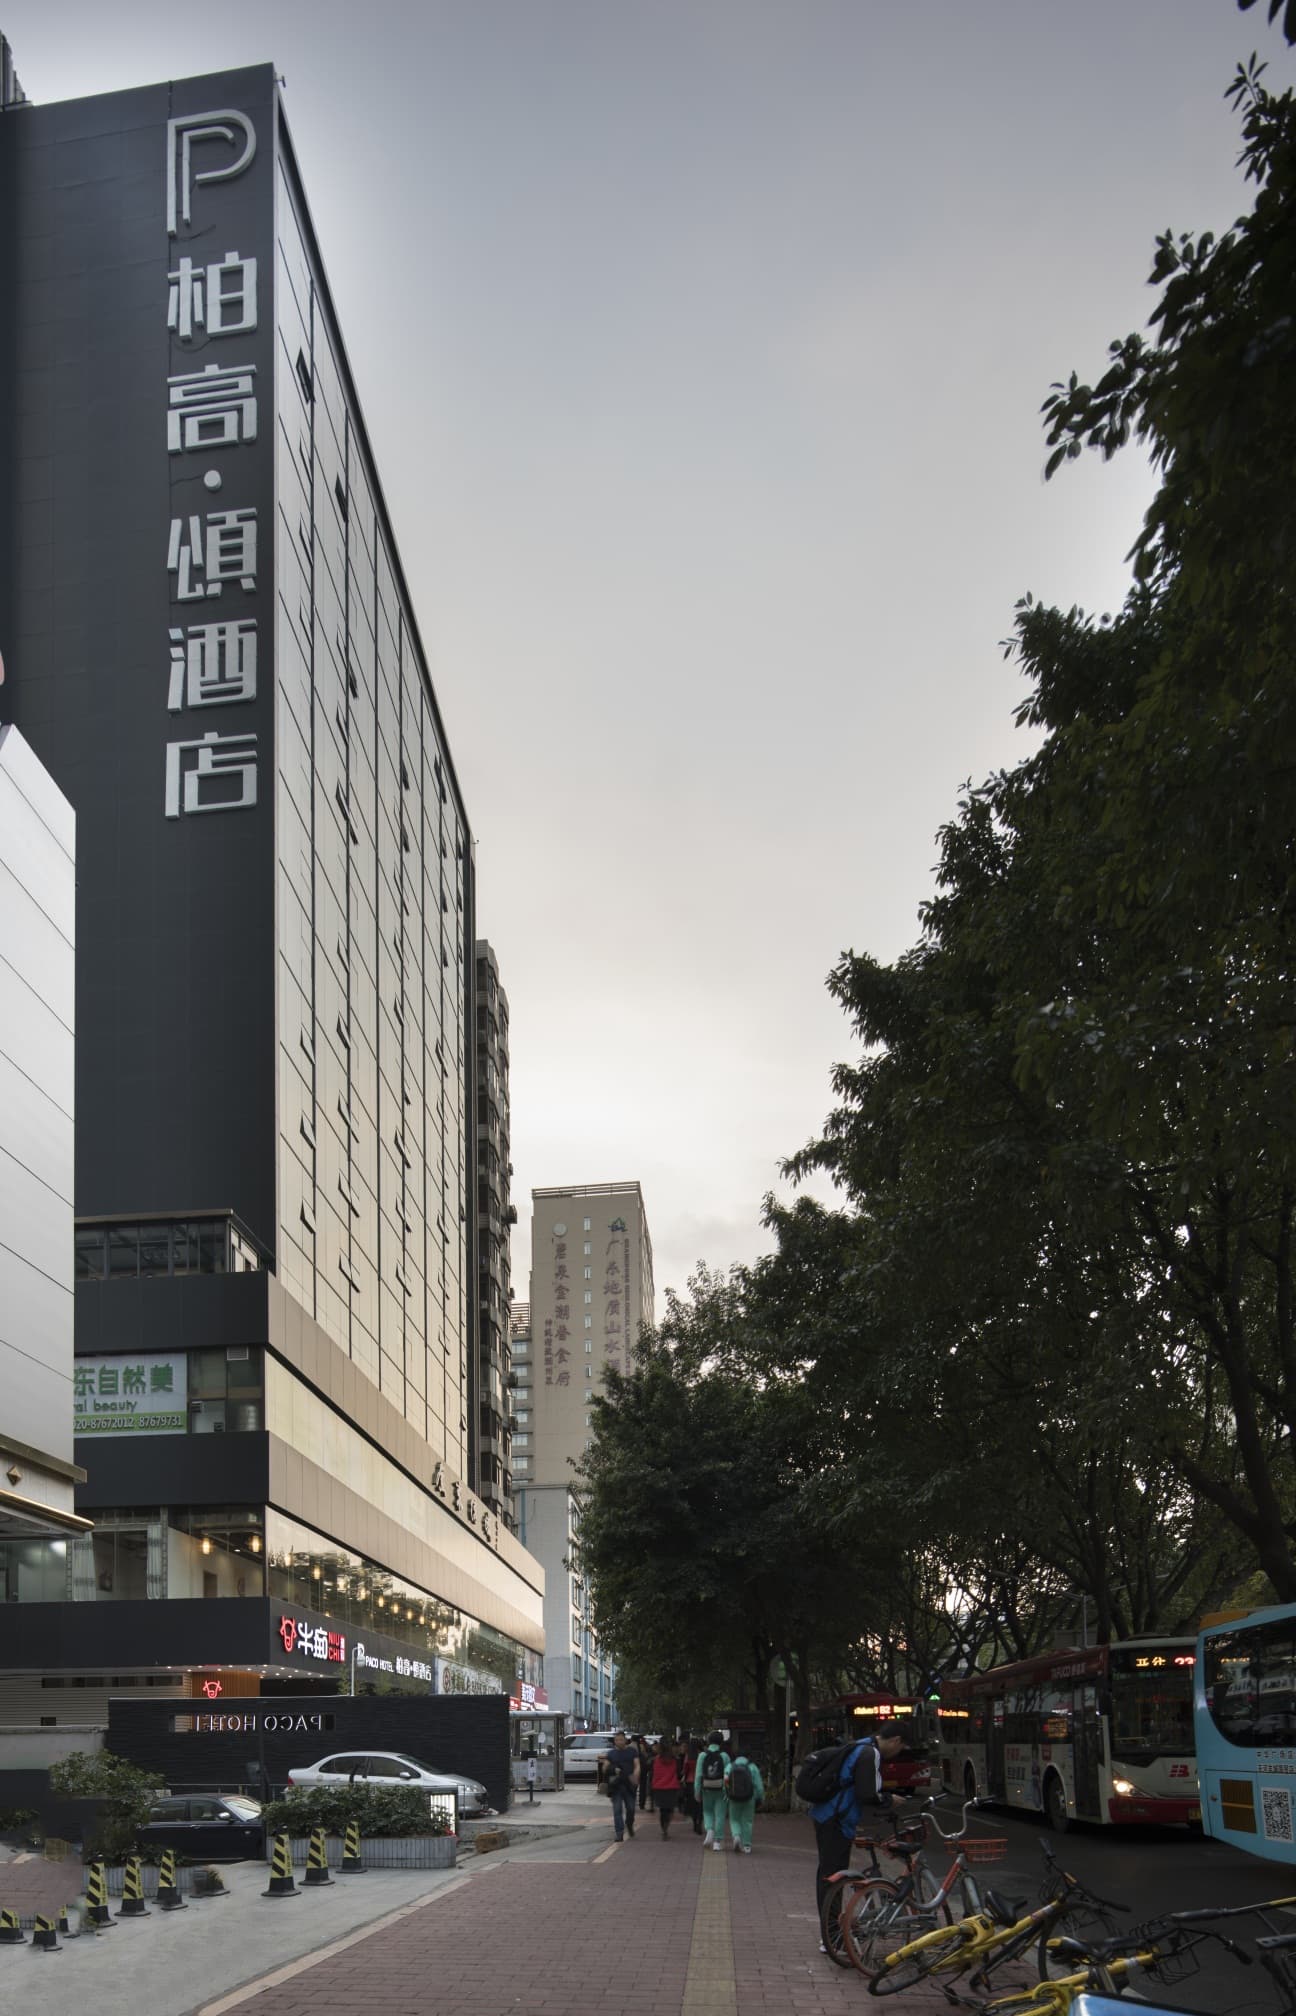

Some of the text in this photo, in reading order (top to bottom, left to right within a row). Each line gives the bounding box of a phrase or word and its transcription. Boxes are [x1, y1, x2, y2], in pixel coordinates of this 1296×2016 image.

[93, 1400, 138, 1413] beauty
[328, 1631, 340, 1646] NIU
[328, 1647, 340, 1661] CHI
[365, 1656, 394, 1673] PACO HOTEL
